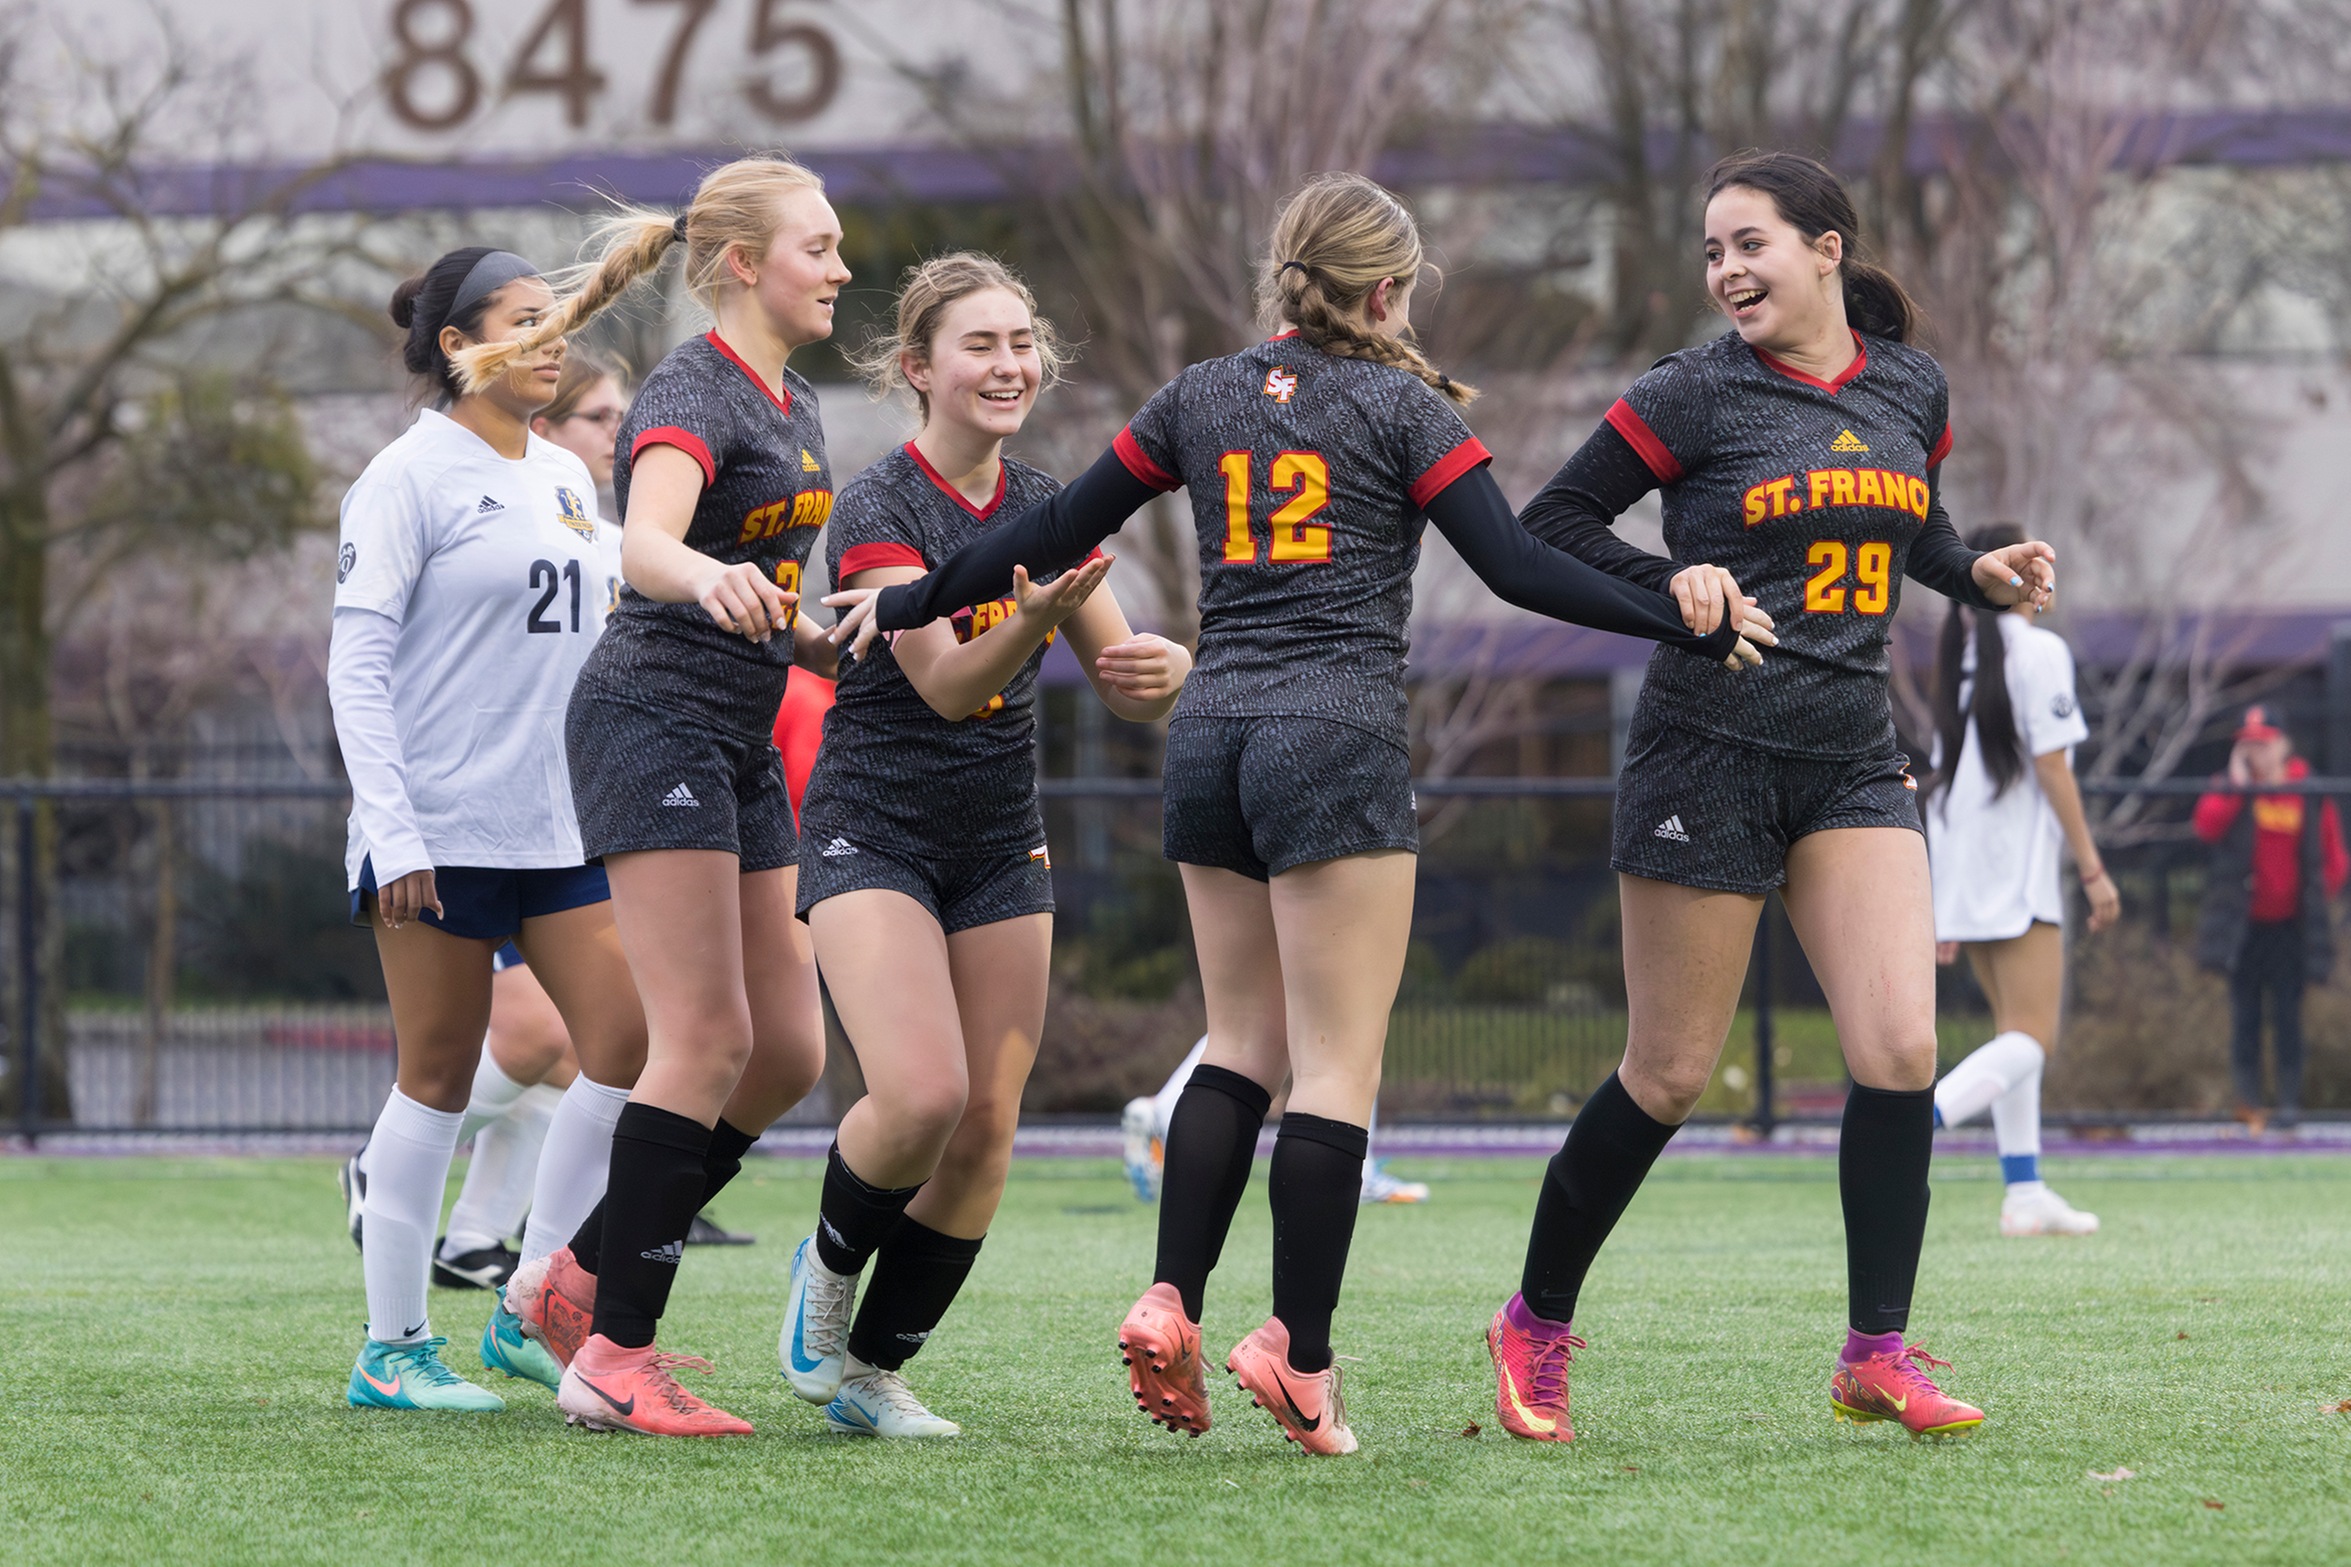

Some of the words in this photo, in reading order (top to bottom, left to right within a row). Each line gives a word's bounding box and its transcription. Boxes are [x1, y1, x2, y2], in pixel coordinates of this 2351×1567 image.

[380, 0, 842, 133] 8475
[1264, 365, 1297, 403] SF
[1830, 443, 1870, 452] adidas
[735, 497, 789, 549] ST.
[1218, 450, 1332, 564] 12
[1743, 474, 1804, 531] ST.
[527, 559, 581, 634] 21
[1803, 540, 1892, 616] 29
[662, 797, 699, 807] adidas
[822, 845, 858, 857] adidas
[1654, 828, 1690, 842] adidas
